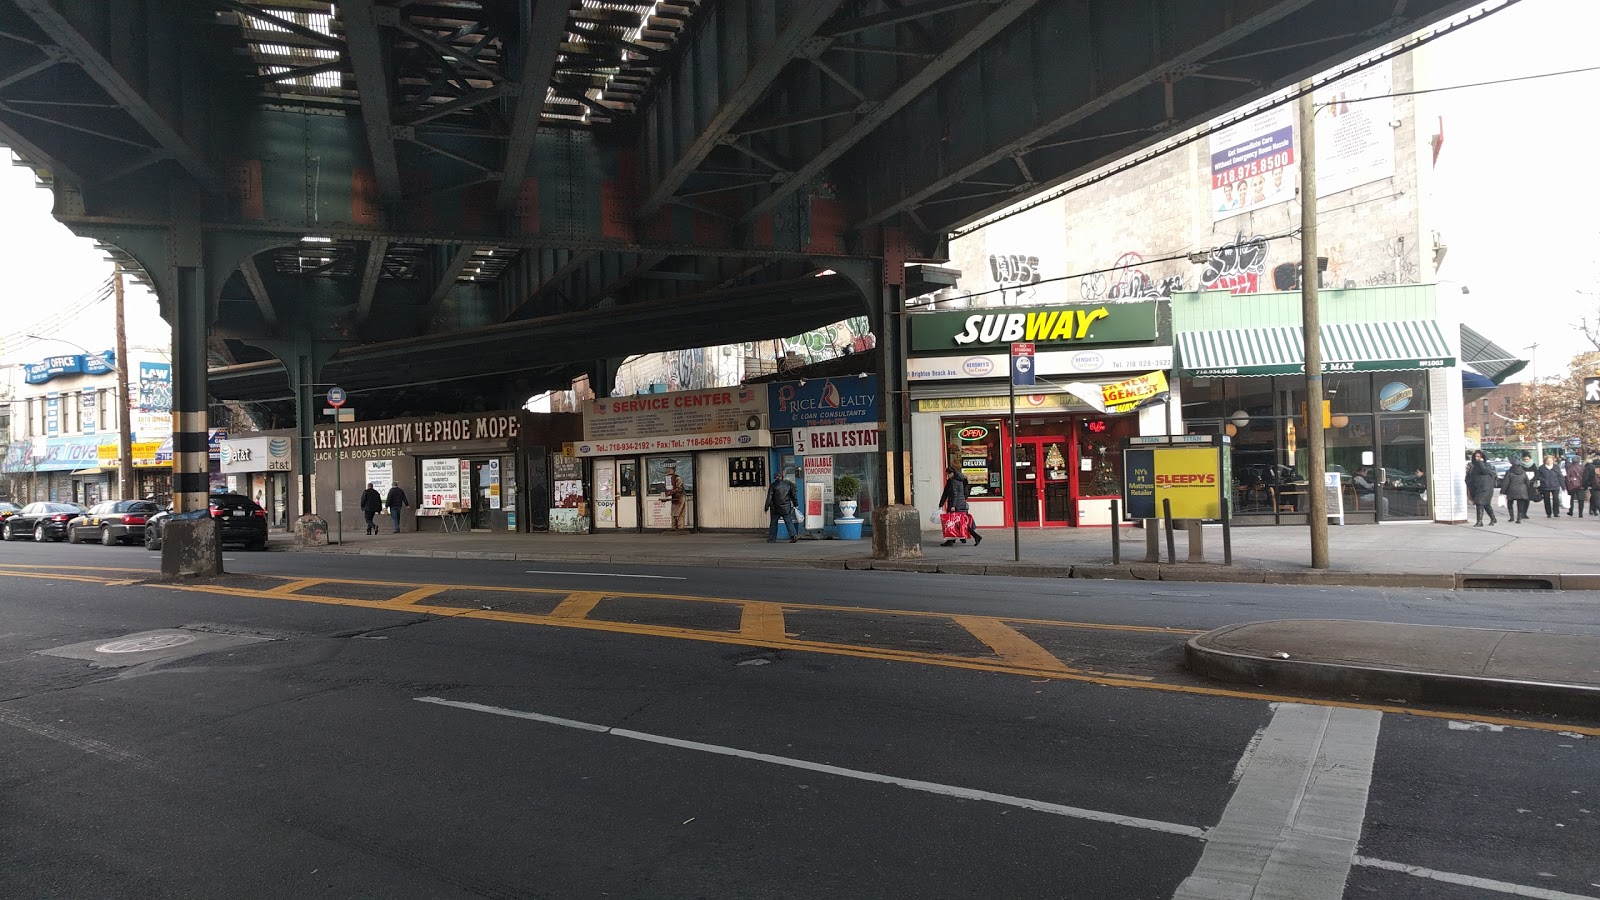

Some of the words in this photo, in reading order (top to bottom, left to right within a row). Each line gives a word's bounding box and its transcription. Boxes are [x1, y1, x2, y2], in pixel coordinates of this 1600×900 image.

[1228, 149, 1236, 157] Get
[1236, 140, 1261, 153] Immediate
[1262, 137, 1273, 145] Care
[1214, 159, 1232, 170] Without
[1233, 151, 1257, 163] Emergency
[1258, 145, 1272, 155] Room
[1273, 140, 1289, 150] Hassle
[1216, 152, 1288, 187] 718.975.8500
[954, 307, 1109, 345] SUBWAY
[50, 356, 75, 367] OFFICE
[142, 368, 167, 379] LAW
[1301, 364, 1327, 372] CE
[613, 398, 669, 413] SERVICE
[674, 392, 732, 408] CENTER
[820, 410, 866, 418] CONSULTANTS
[370, 423, 412, 444] КНИГИ
[415, 420, 470, 441] ЧЕРНОЕ
[476, 416, 517, 438] МОРЕ
[596, 444, 608, 452] Tel.:
[609, 442, 650, 451] 718-934-2192
[686, 436, 732, 446] 718-646-2679
[811, 431, 839, 448] REAL
[232, 449, 251, 461] at&t
[352, 448, 396, 458] BOOKSTORE
[269, 461, 289, 470] at&t
[735, 460, 754, 470] FOR
[805, 457, 832, 468] AVAILABLE
[732, 472, 756, 480] RENT
[1156, 474, 1215, 483] SLEEPY'S
